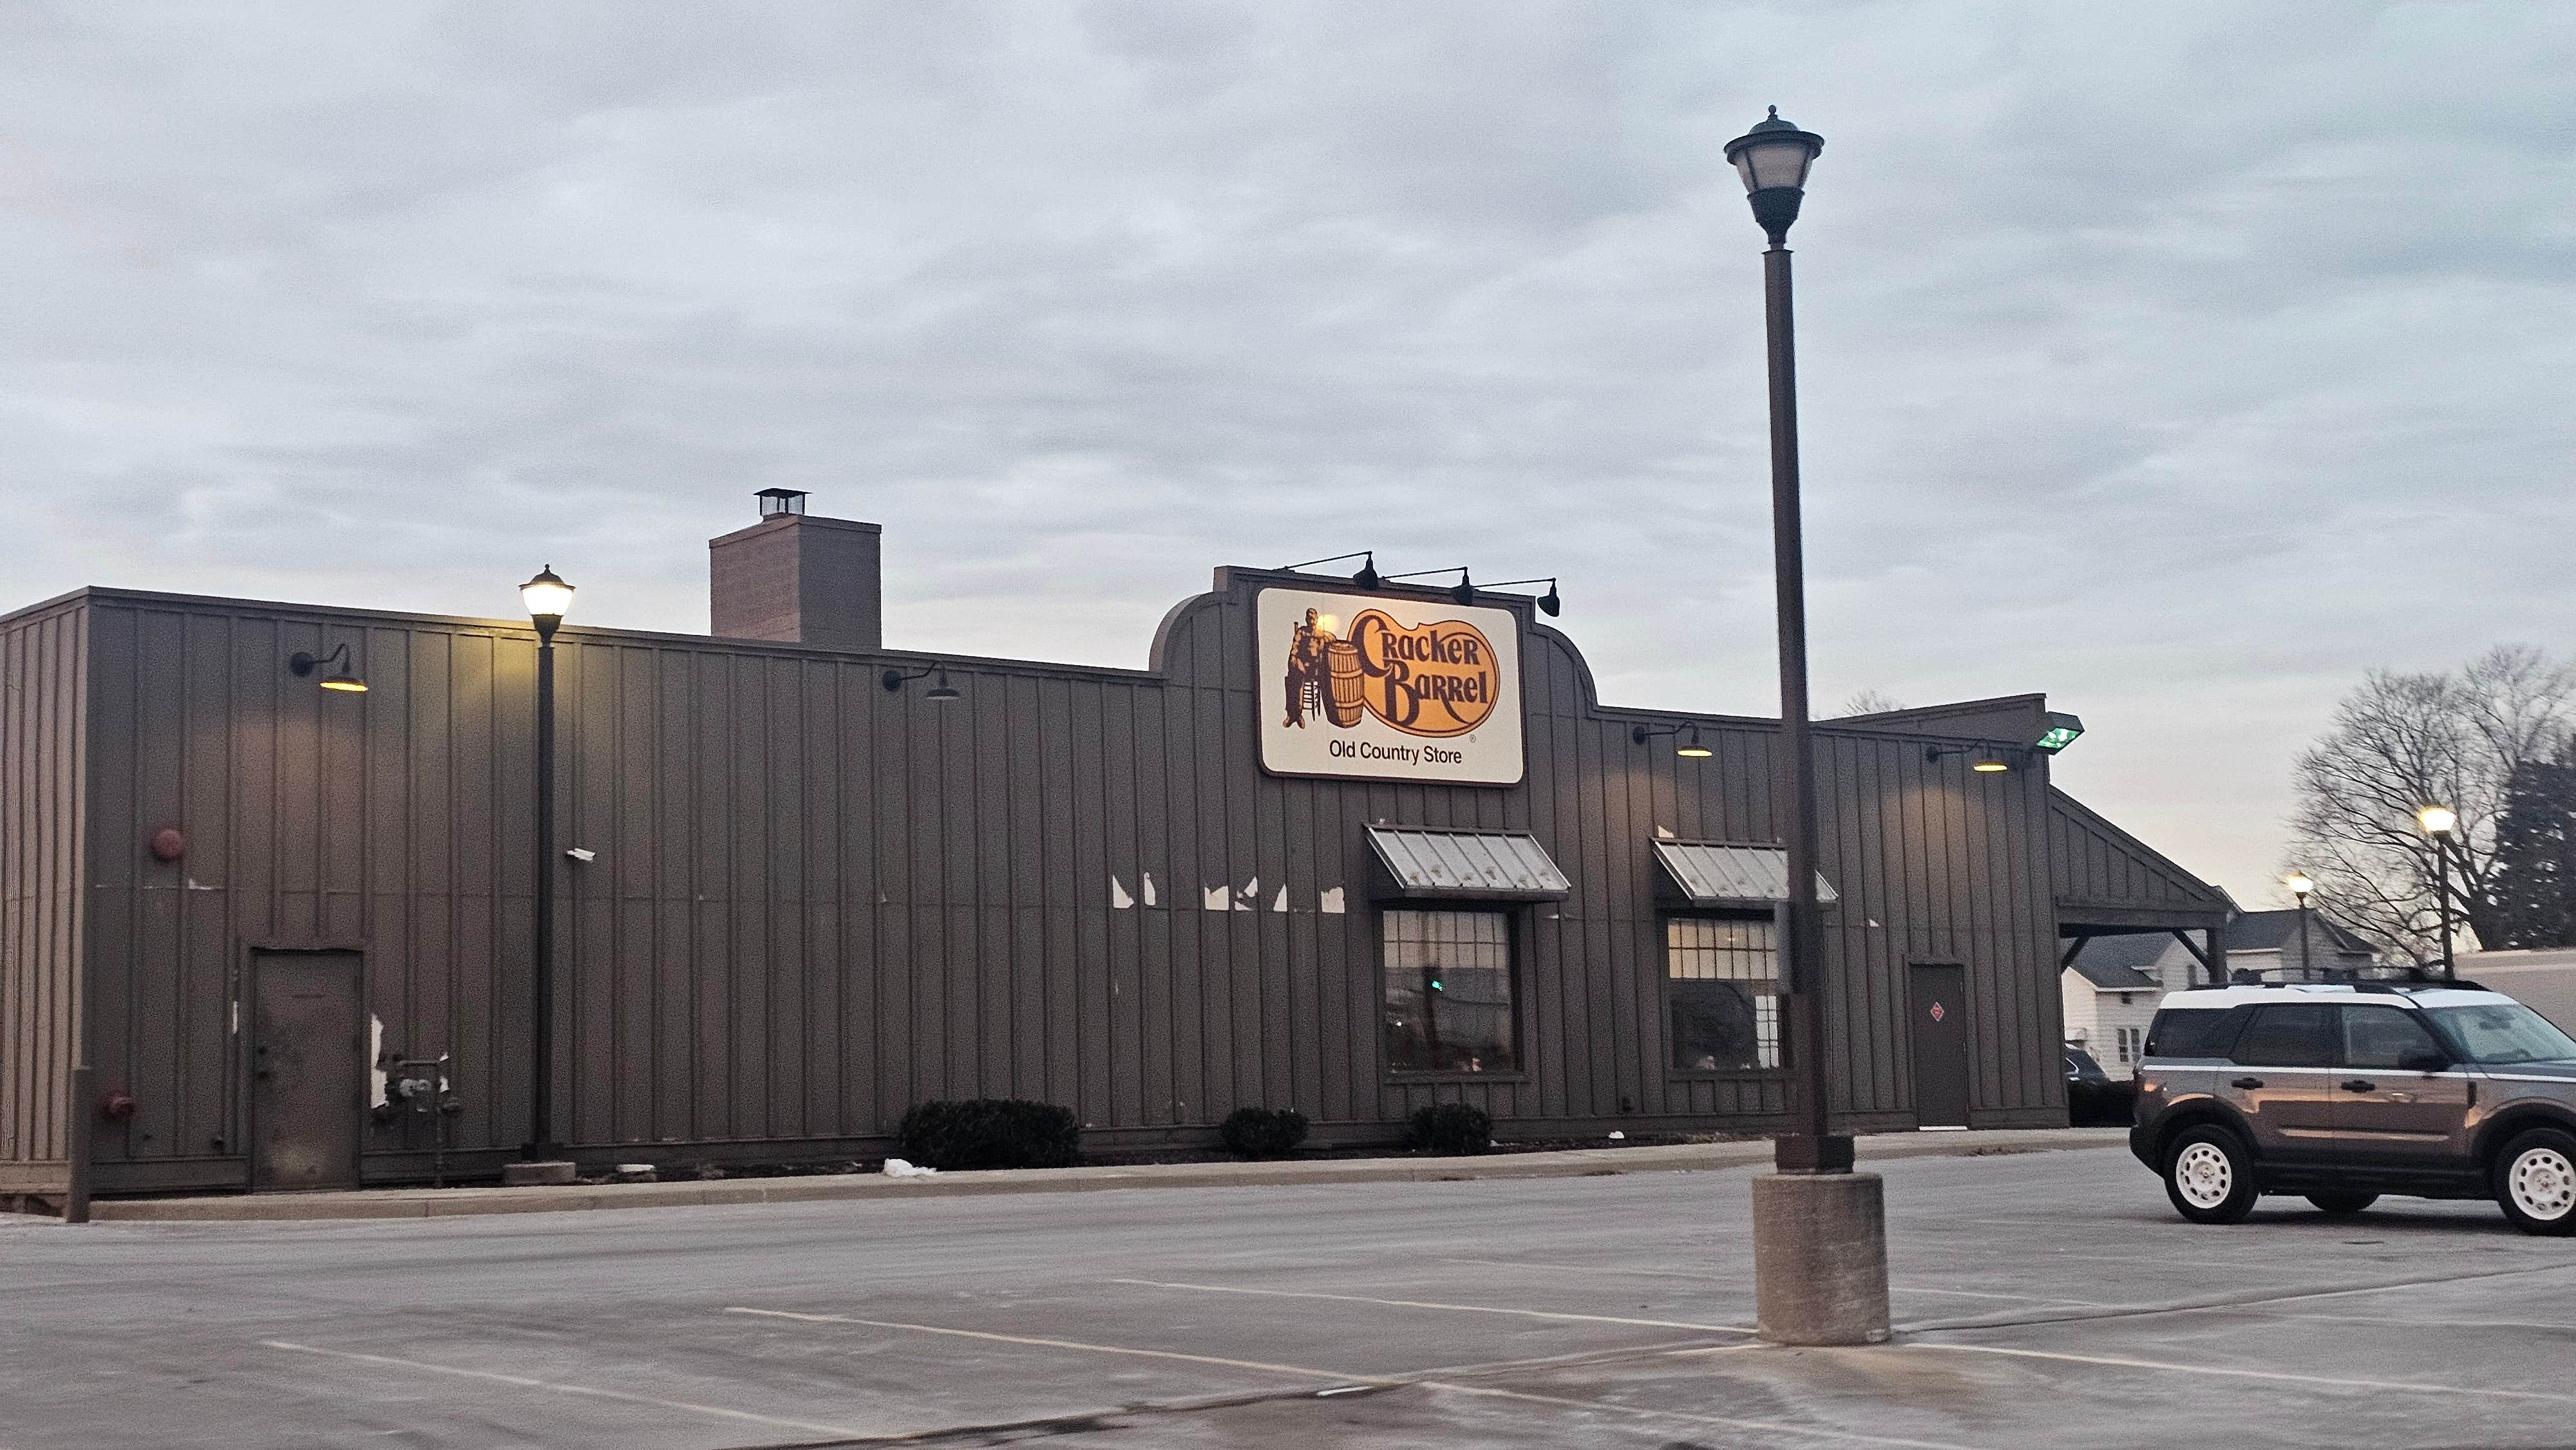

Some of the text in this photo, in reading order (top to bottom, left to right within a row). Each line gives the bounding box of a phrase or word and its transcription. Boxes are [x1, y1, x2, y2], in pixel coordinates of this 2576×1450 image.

[1329, 740, 1462, 766] Old Country Store
